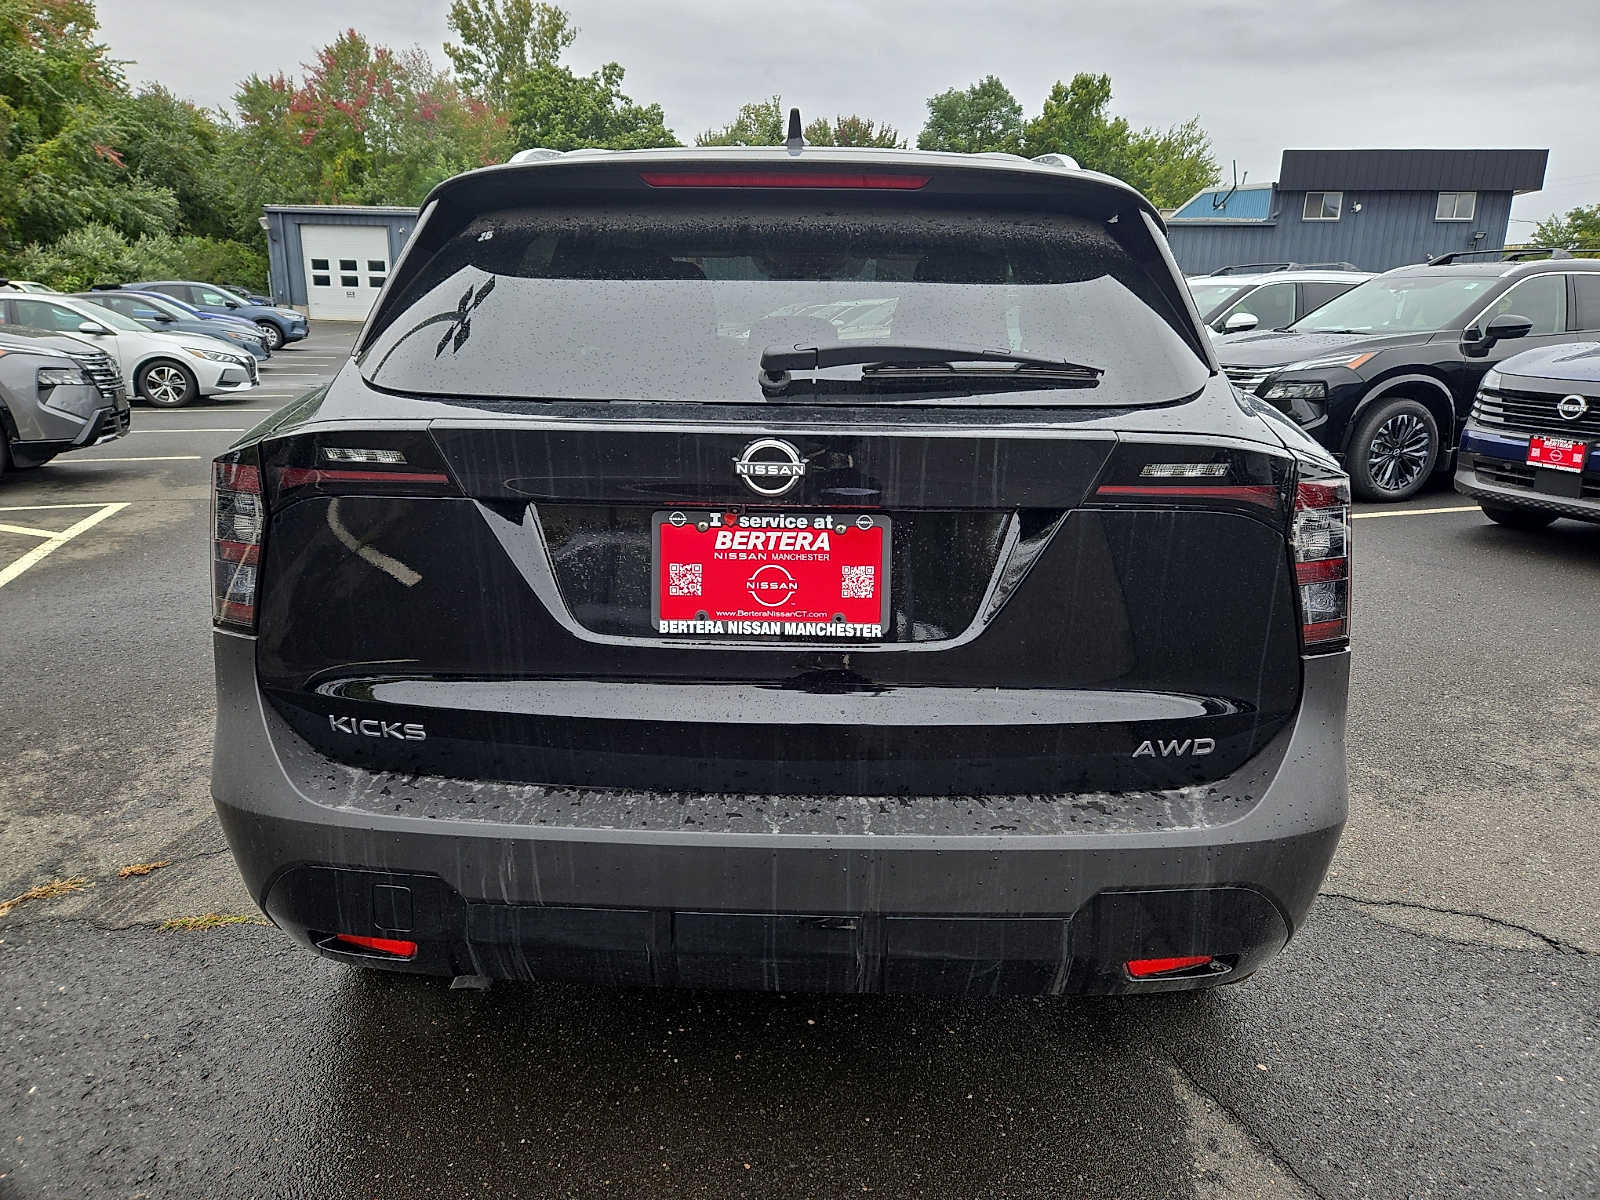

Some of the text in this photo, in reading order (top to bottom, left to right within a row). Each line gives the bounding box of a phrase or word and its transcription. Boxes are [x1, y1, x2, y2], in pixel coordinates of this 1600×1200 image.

[736, 464, 804, 475] NISSAN
[710, 512, 833, 529] I service at
[714, 531, 831, 551] BERTERA
[714, 552, 830, 561] NISSAN MANCHESTER
[746, 582, 798, 590] NISSAN
[716, 609, 828, 618] www.BerteraNissanCT.com
[659, 620, 882, 638] BERTERA NISSAN MANCHESTER
[328, 714, 427, 741] KICKS
[1132, 738, 1216, 758] AWD
